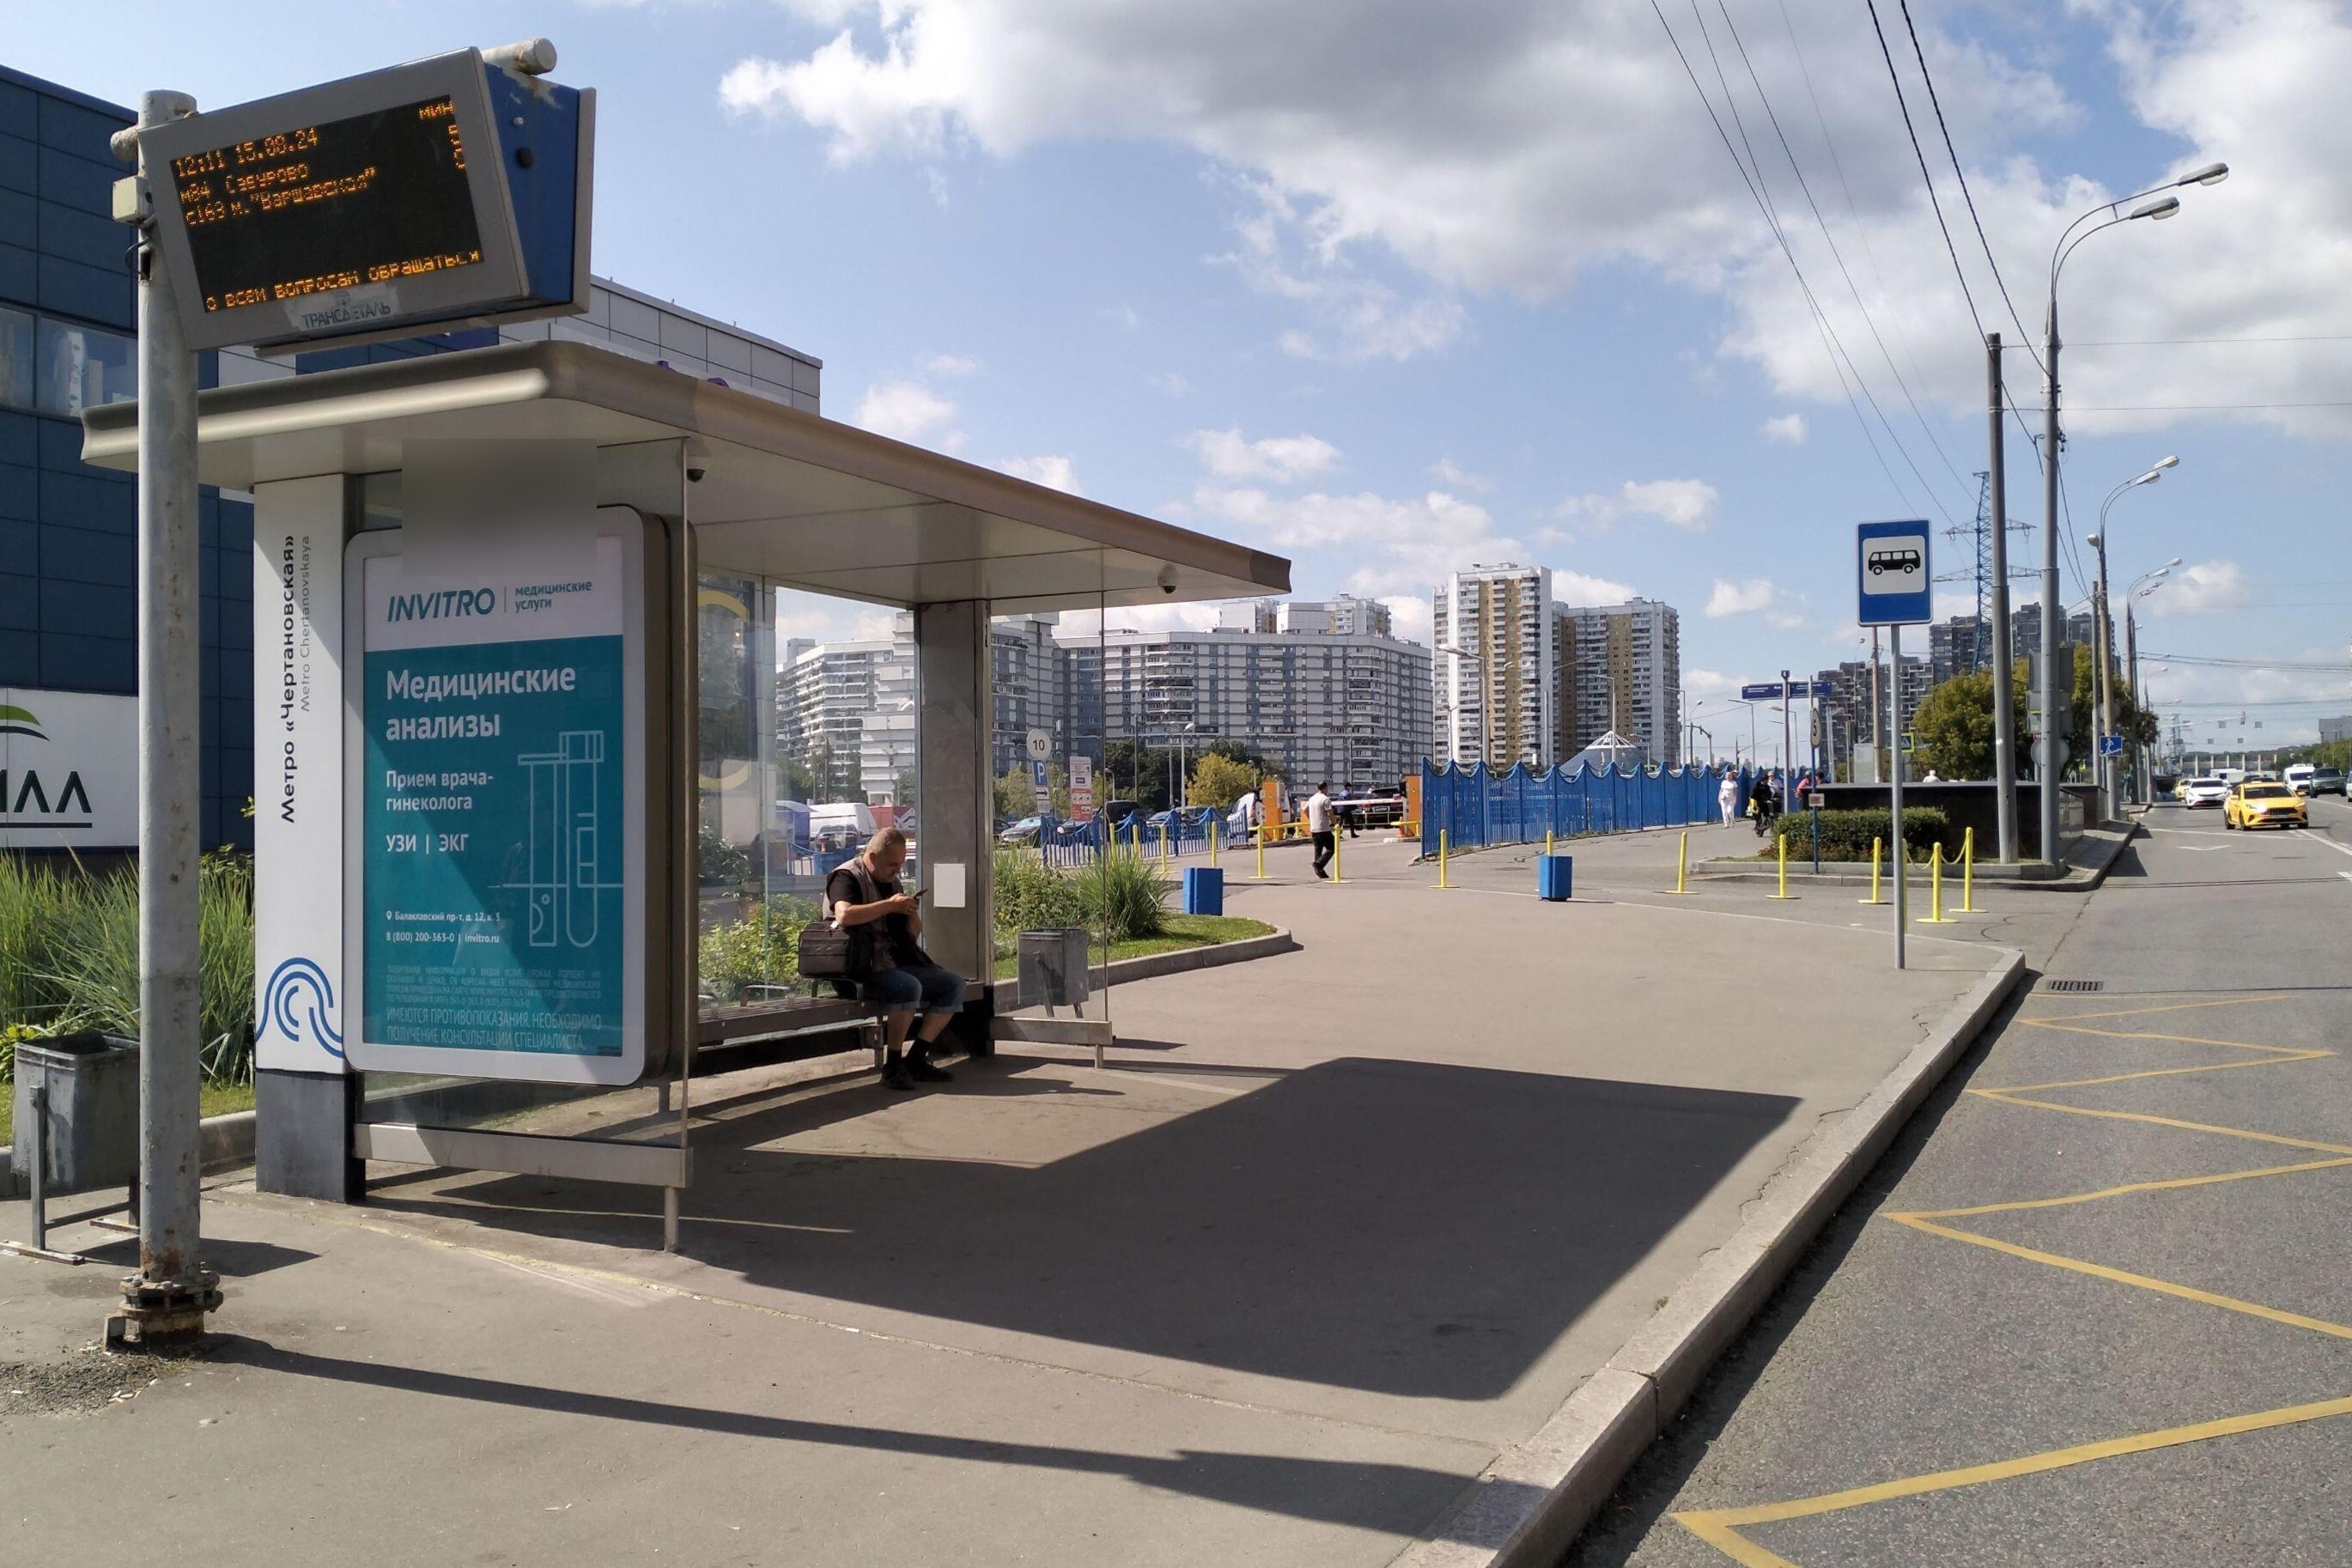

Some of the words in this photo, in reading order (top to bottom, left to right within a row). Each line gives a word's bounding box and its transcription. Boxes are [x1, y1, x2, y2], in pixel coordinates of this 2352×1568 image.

[236, 127, 318, 163] 15.08.24
[515, 580, 593, 598] медицинские
[387, 587, 495, 623] INVITRO
[515, 598, 552, 613] услуги
[281, 535, 298, 732] «Чертановская»
[301, 663, 311, 712] Metro
[387, 666, 576, 702] Медицинские
[386, 714, 501, 741] анализы
[1032, 739, 1045, 751] 10
[281, 741, 298, 824] Метро
[386, 770, 436, 791] Прием
[441, 771, 493, 790] врача-
[1037, 763, 1045, 783] P
[386, 795, 472, 811] гинеколога
[386, 834, 416, 852] УЗИ
[438, 834, 470, 852] ЭКГ
[395, 910, 445, 922] Балаклавский
[386, 933, 392, 942] 8
[392, 933, 413, 944] (800)
[415, 933, 455, 943] 200-363-0
[465, 933, 500, 944] invitro.ru
[386, 1007, 429, 1025] ИМЕЮТСЯ
[430, 1008, 531, 1028] ПРОТИВОПОКАЗАНИЯ.
[532, 1012, 601, 1030] НЕОБХОДИМО
[386, 1026, 439, 1044] ПОЛУЧЕНИЕ
[441, 1029, 514, 1048] КОНСУЛЬТАЦИИ
